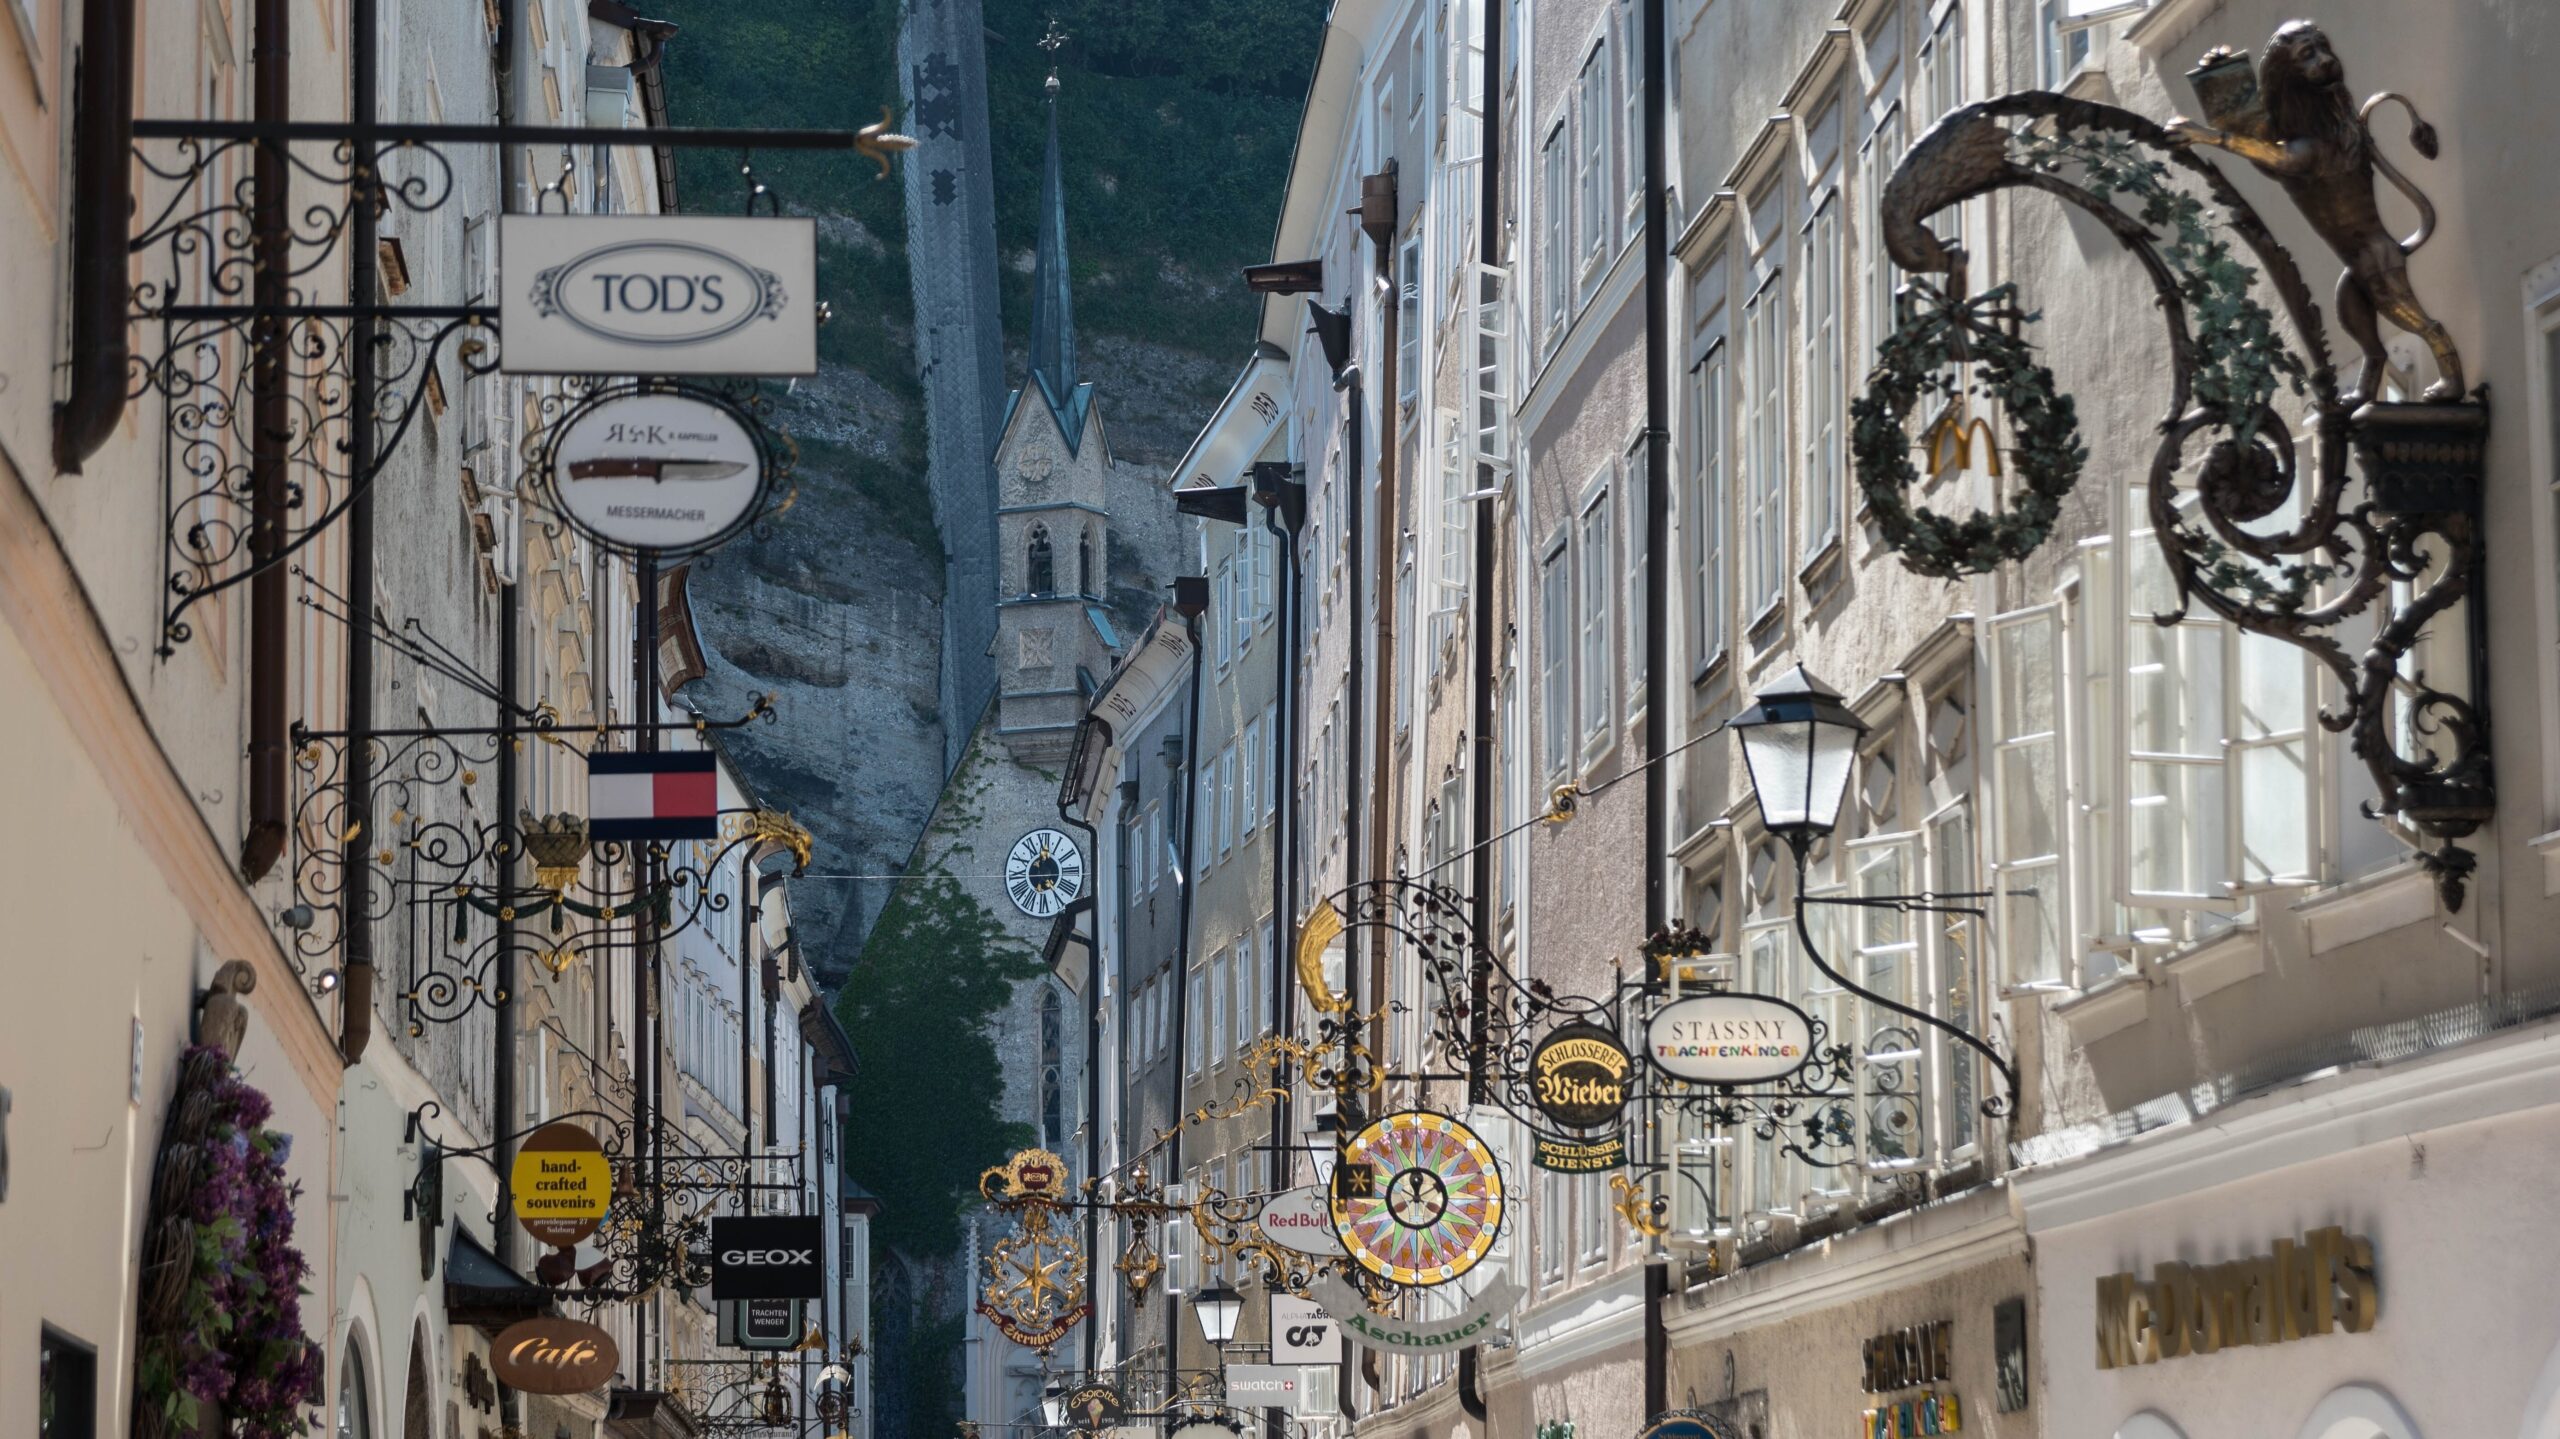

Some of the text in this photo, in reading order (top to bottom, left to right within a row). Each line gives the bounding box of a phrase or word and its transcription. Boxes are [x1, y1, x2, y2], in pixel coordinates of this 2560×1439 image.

[592, 273, 724, 314] TOD'S
[606, 505, 706, 521] MESSERMACHER
[1672, 1020, 1785, 1041] STASSNY
[1542, 1042, 1622, 1069] SCHLOSSEREI
[1537, 1073, 1623, 1105] Wieber
[541, 1159, 582, 1173] hand-
[1545, 1154, 1614, 1169] DIENST
[536, 1177, 587, 1191] crafted
[527, 1194, 596, 1209] souvenirs
[1269, 1213, 1328, 1227] Red Bull
[722, 1249, 812, 1265] GEOX
[752, 1309, 788, 1317] TRACHTEN
[754, 1318, 784, 1326] WENGER
[1345, 1312, 1491, 1347] Aschauer
[508, 1337, 598, 1369] Café
[1231, 1380, 1284, 1391] swatch
